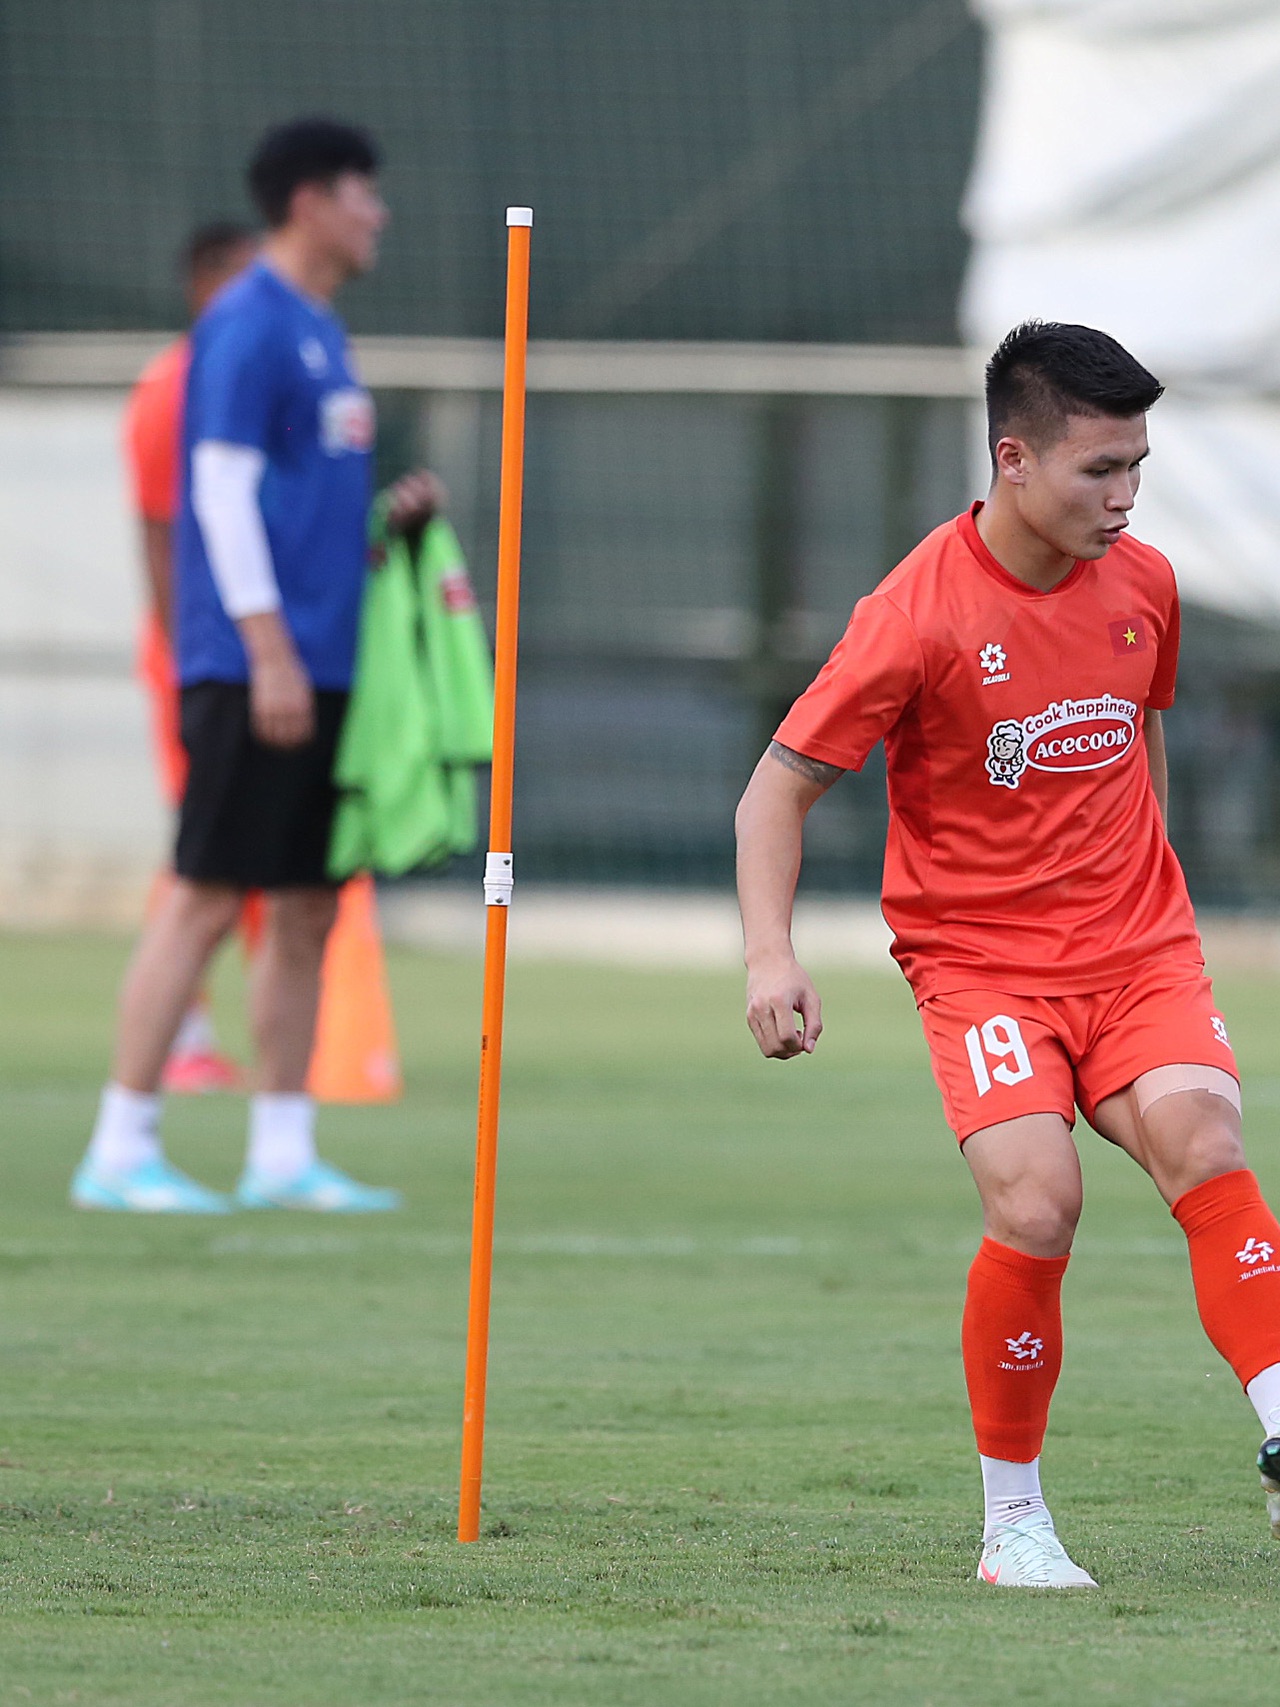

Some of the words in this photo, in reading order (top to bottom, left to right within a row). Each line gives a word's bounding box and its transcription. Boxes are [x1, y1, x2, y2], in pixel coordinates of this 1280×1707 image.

[1025, 707, 1063, 734] Cook
[1066, 698, 1135, 718] happiness
[964, 1014, 1034, 1098] 19
